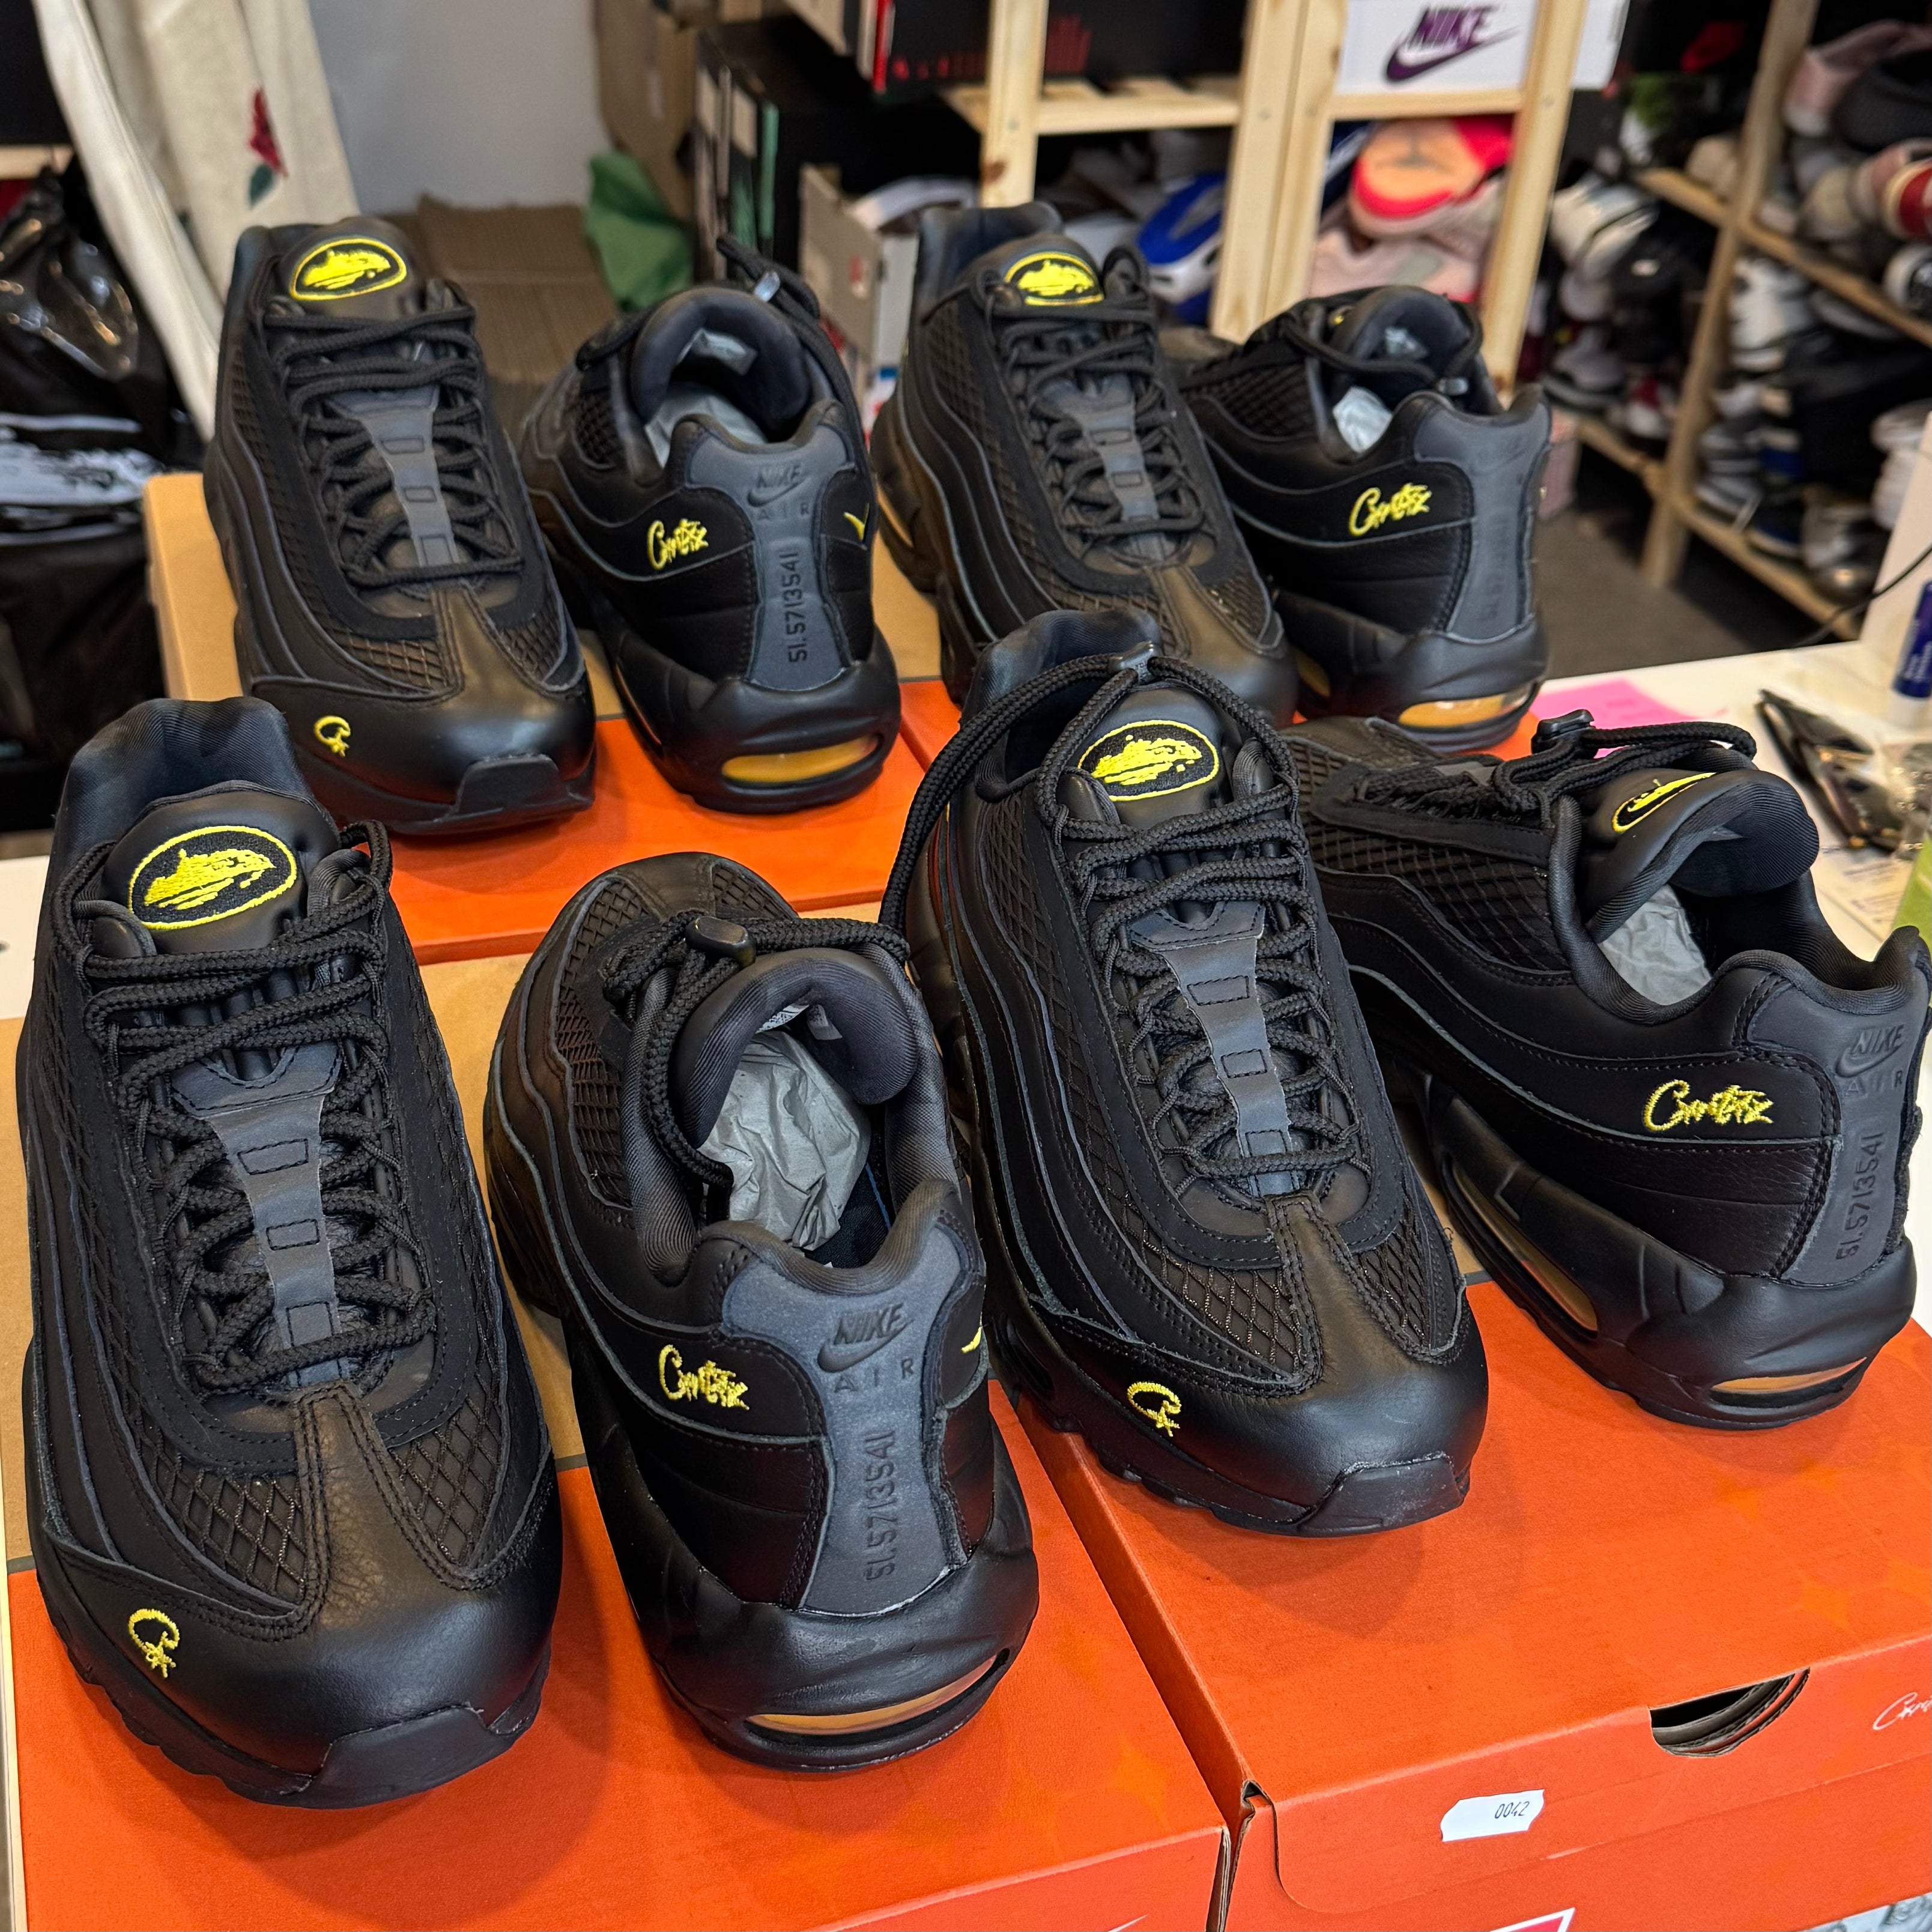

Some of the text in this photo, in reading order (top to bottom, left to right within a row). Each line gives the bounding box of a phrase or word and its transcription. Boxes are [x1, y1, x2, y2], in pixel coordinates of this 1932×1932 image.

[757, 503, 811, 520] AIR
[1850, 1024, 1905, 1056] NIKE
[1845, 1071, 1904, 1097] AIR
[832, 1302, 904, 1346] NIKE
[834, 1357, 915, 1393] AIR
[1494, 1800, 1530, 1820] 0042
